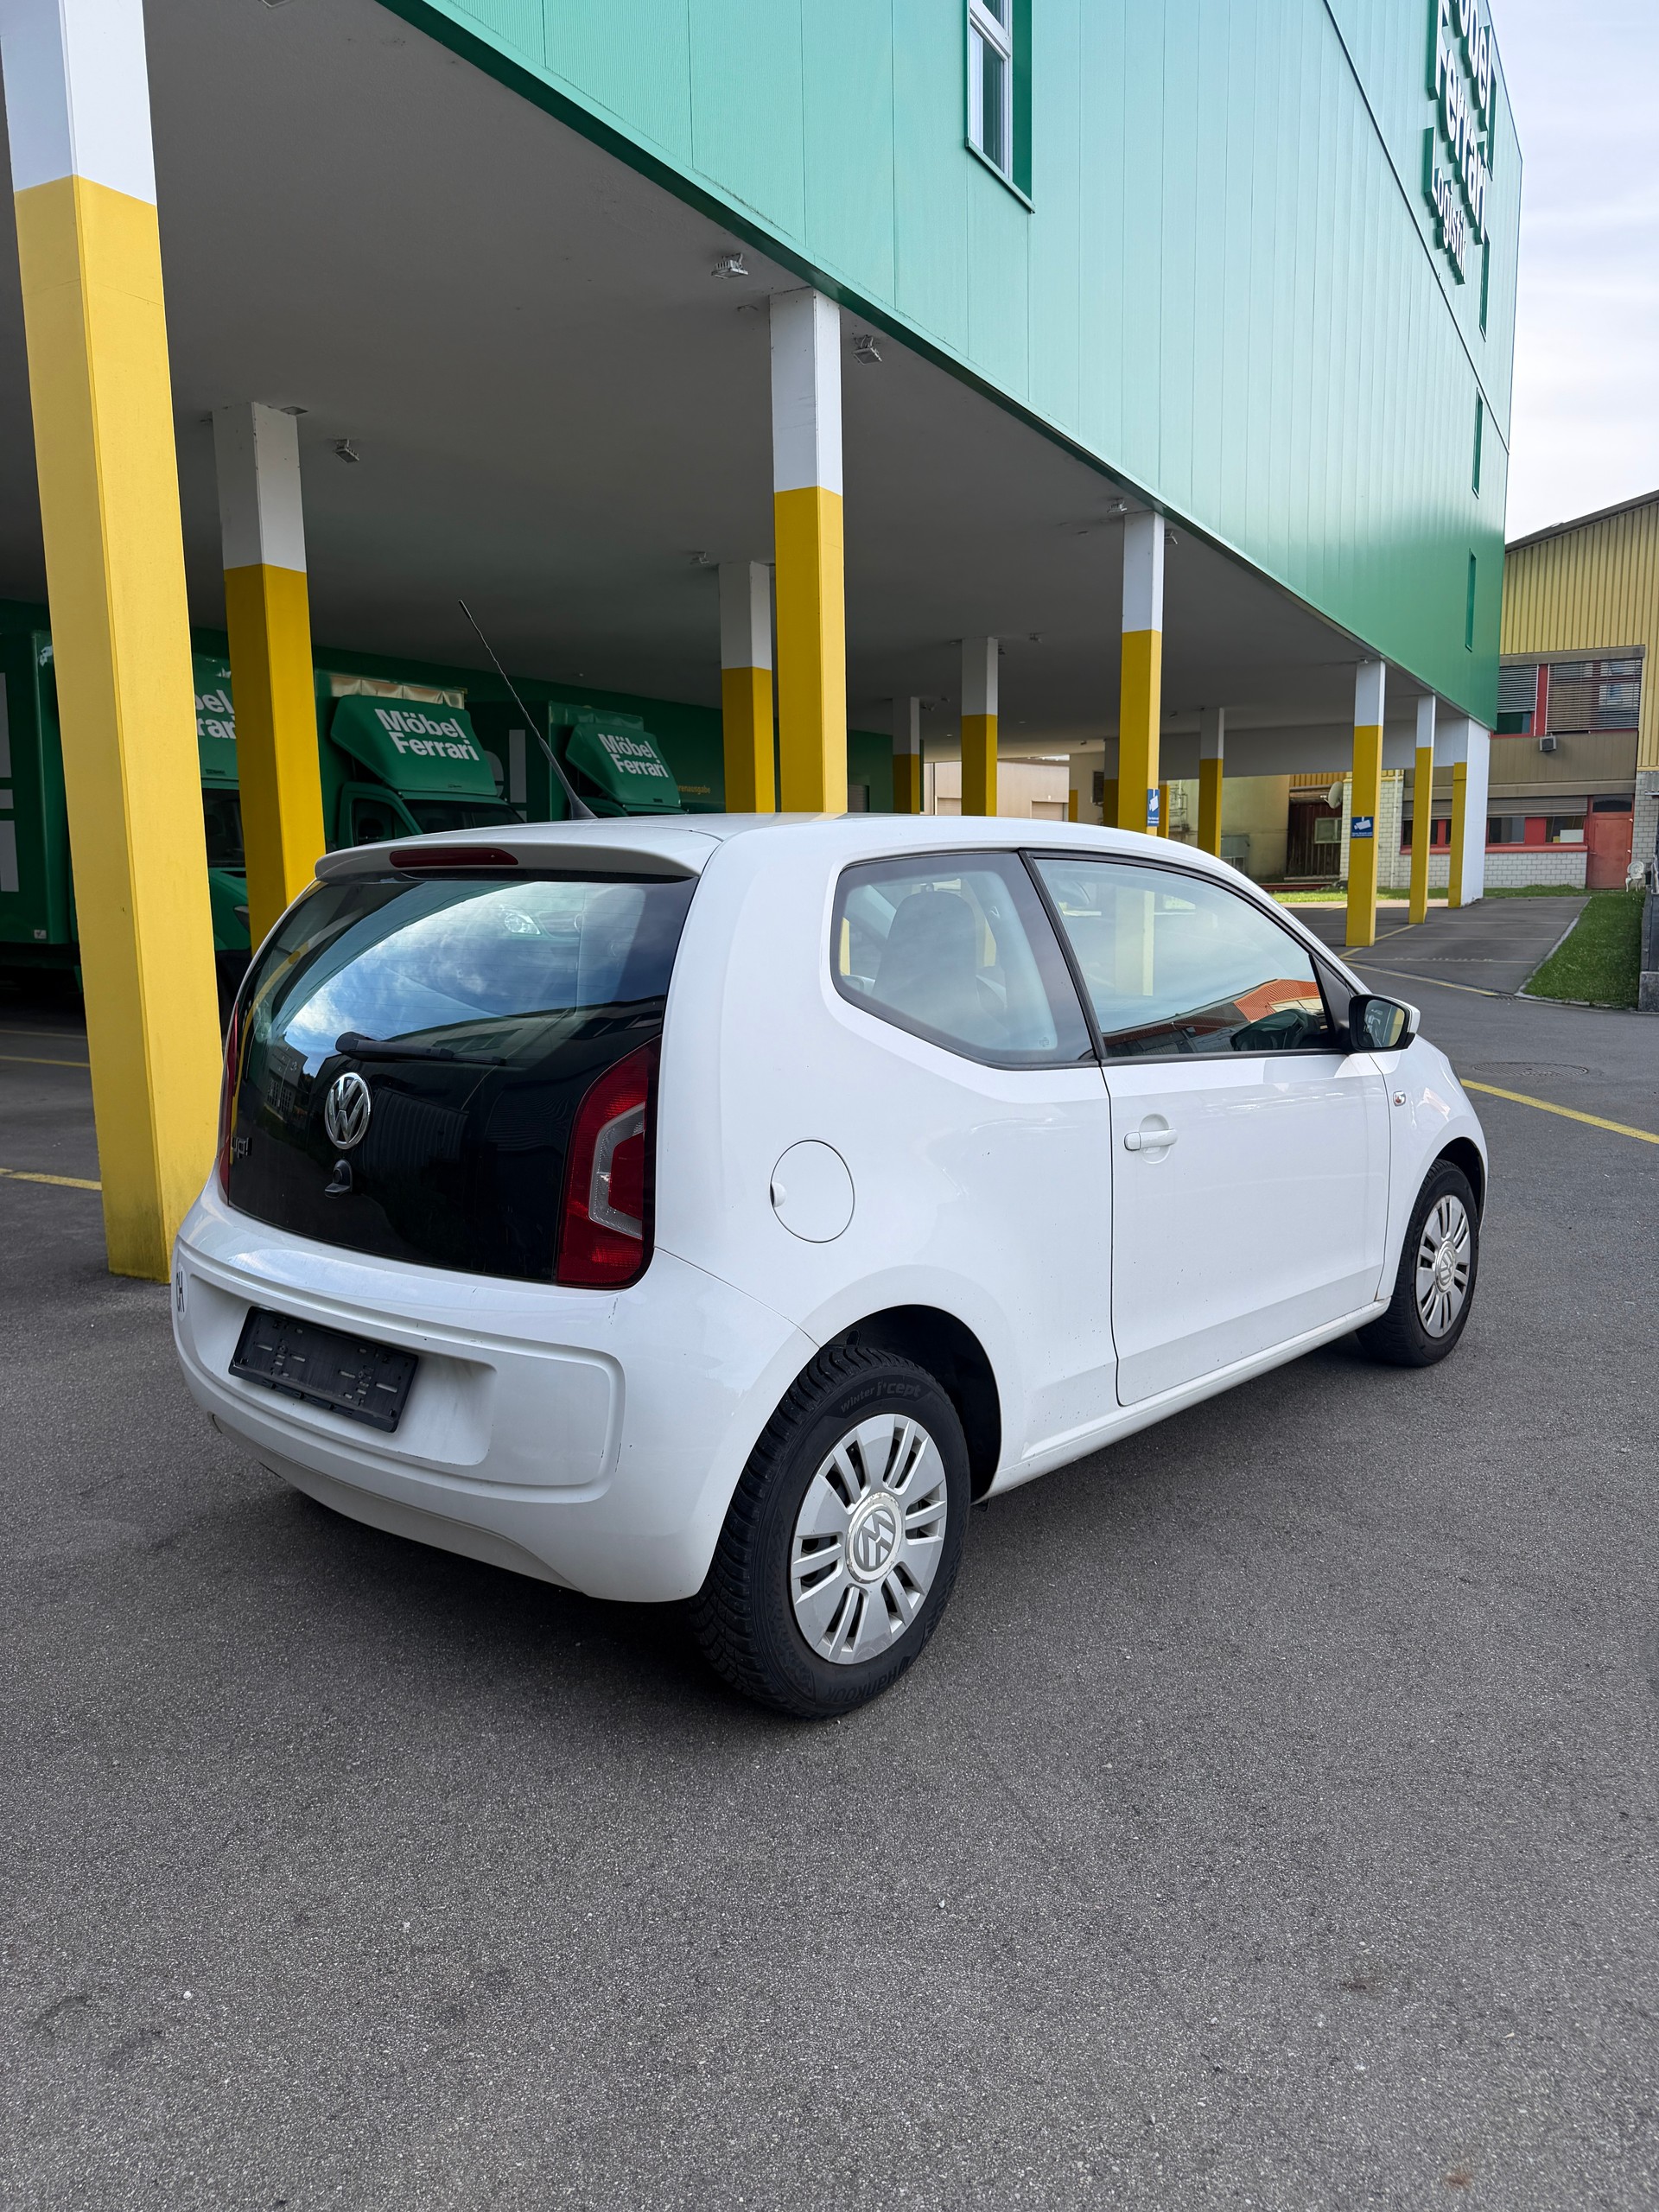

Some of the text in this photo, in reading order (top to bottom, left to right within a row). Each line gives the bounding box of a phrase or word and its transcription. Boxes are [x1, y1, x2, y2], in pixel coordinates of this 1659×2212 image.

[1455, 0, 1494, 132] bel
[1431, 126, 1468, 283] Logistik
[374, 709, 467, 739] Möbel
[388, 732, 480, 760] Ferrari
[598, 734, 658, 759] Möbel
[610, 753, 669, 778] Ferrari
[325, 1072, 371, 1149] VW
